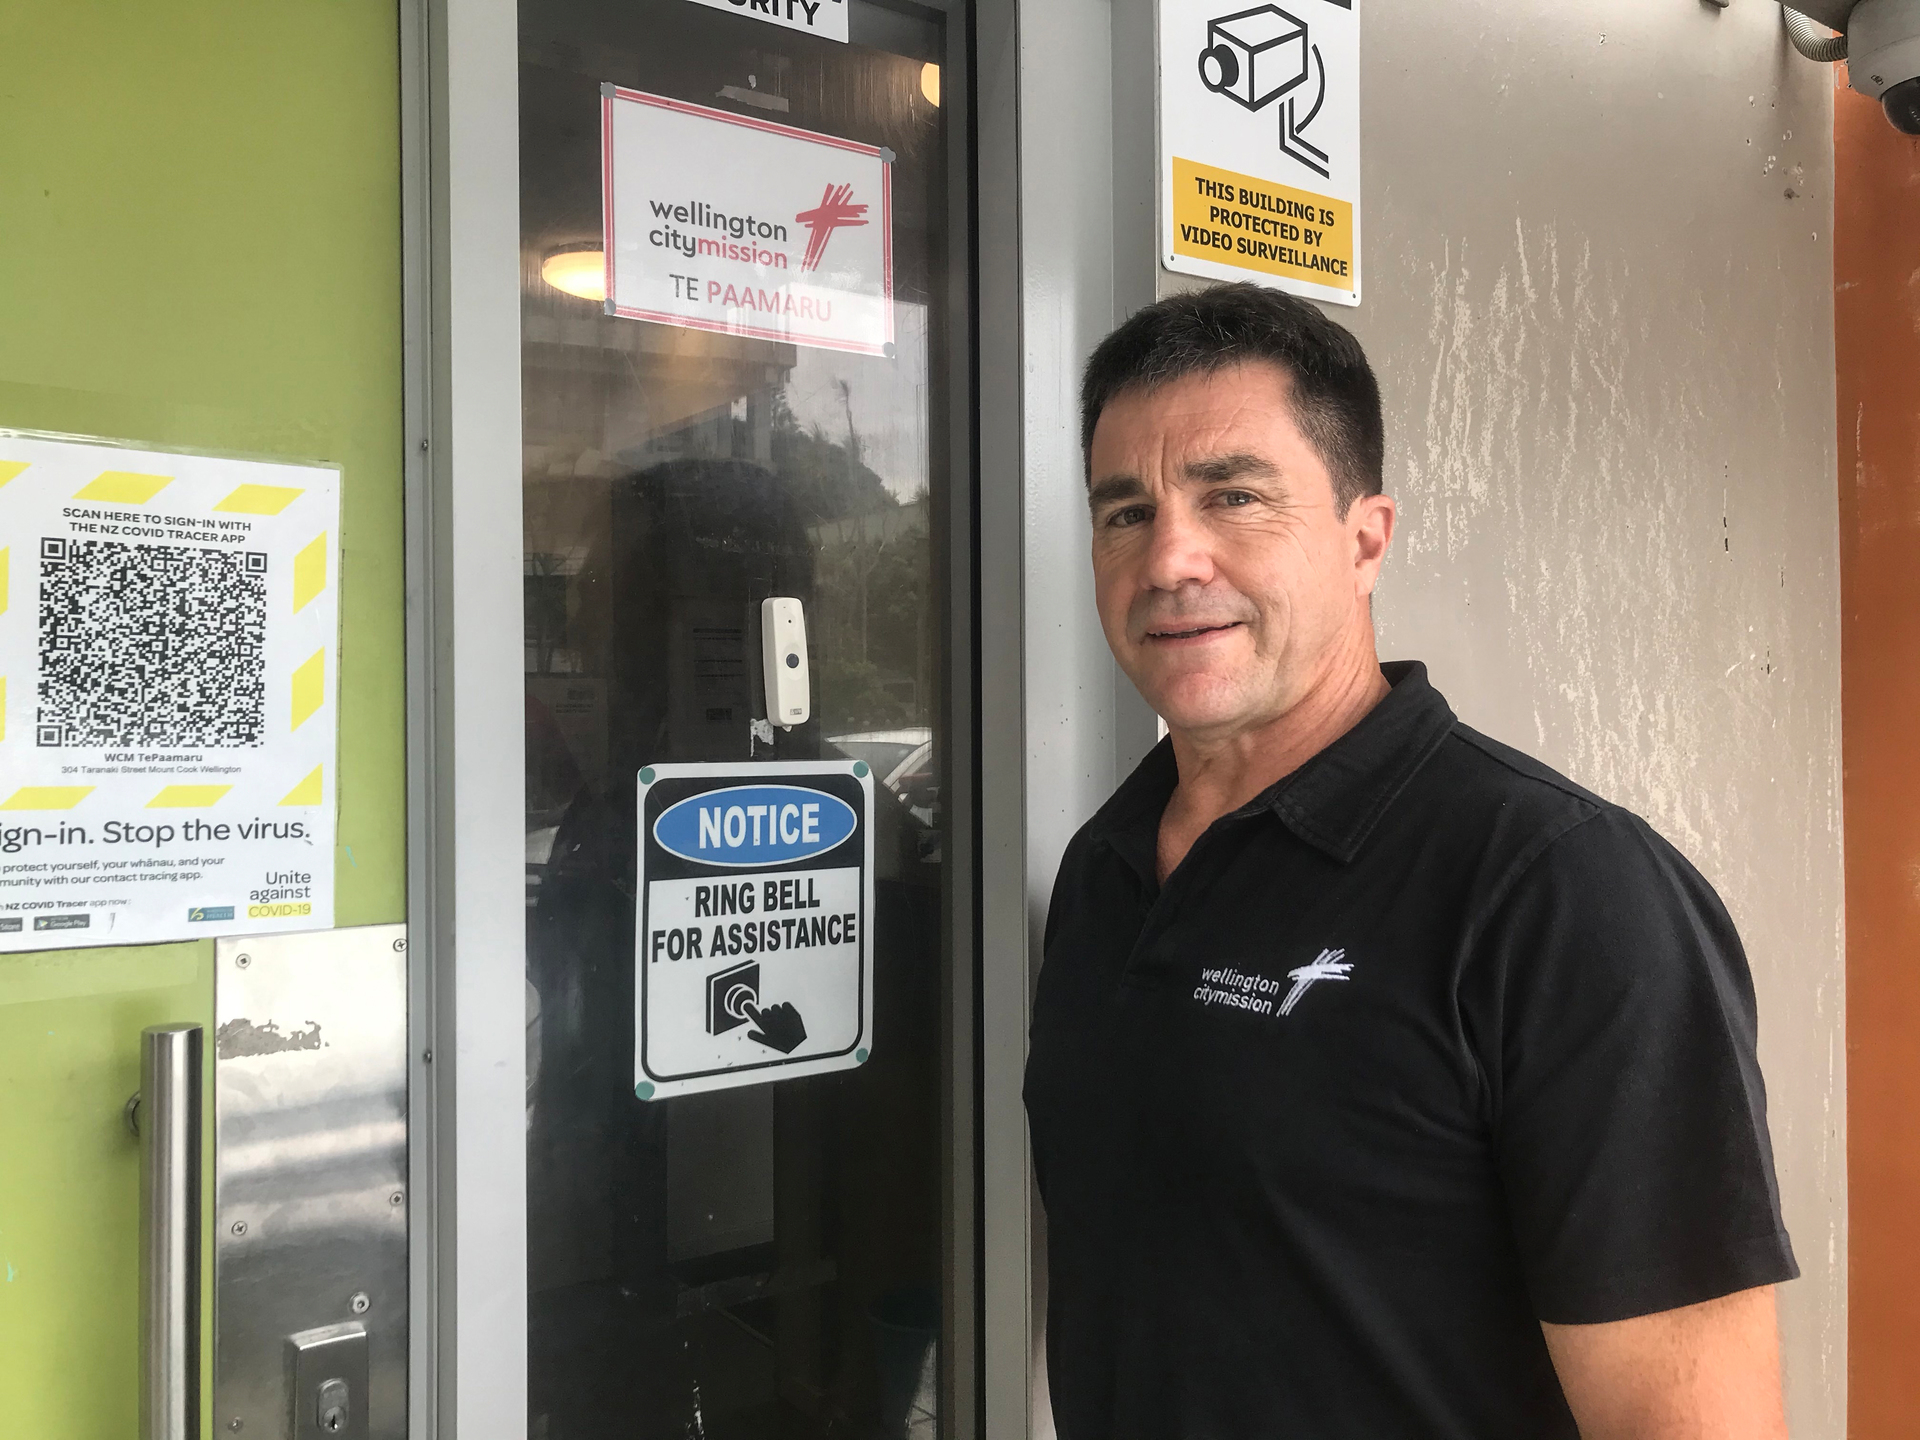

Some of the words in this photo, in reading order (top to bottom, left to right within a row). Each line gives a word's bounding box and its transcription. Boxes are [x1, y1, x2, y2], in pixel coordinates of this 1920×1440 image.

[1195, 176, 1235, 202] THIS
[1239, 188, 1314, 223] BUILDING
[1319, 209, 1335, 227] IS
[649, 200, 788, 242] wellington
[1209, 205, 1300, 242] PROTECTED
[1304, 231, 1323, 247] BY
[649, 225, 788, 269] citymission
[1180, 223, 1233, 251] VIDEO
[1236, 236, 1348, 277] SURVEILLANCE
[669, 273, 699, 301] TE
[707, 280, 832, 321] PAAMARU
[62, 507, 101, 520] SCAN
[104, 511, 140, 523] HERE
[145, 514, 161, 525] TO
[164, 516, 216, 528] SIGN-IN
[218, 520, 251, 531] WITH
[69, 522, 97, 533] THE
[100, 525, 119, 535] NZ
[122, 526, 164, 538] COVID
[167, 530, 218, 542] TRACER
[220, 534, 246, 544] APP
[61, 766, 79, 774] 304
[81, 766, 119, 774] Taranaki
[121, 766, 147, 774] Street
[148, 766, 175, 774] Mount
[176, 765, 199, 773] Cook
[200, 765, 242, 775] Wellington
[104, 753, 134, 762] WCM
[138, 753, 203, 762] TePaamaru
[103, 820, 175, 848] Stop
[182, 818, 231, 841] the
[237, 817, 311, 840] virus.
[699, 803, 820, 849] NOTICE
[3, 863, 48, 874] protect
[50, 860, 100, 873] yourself,
[102, 861, 128, 871] your
[178, 857, 199, 867] and
[200, 857, 225, 867] your
[44, 875, 69, 885] with
[71, 876, 91, 884] our
[93, 873, 137, 883] contact
[139, 871, 178, 881] tracing
[179, 871, 203, 881] app.
[266, 870, 311, 885] Unite
[22, 901, 55, 909] COVID
[56, 900, 88, 908] Tracer
[89, 899, 108, 907] app
[250, 885, 311, 904] against
[694, 881, 755, 918] RING
[763, 877, 820, 912] BELL
[248, 903, 311, 918] COVID-19
[652, 926, 702, 963] FOR
[710, 913, 856, 959] ASSISTANCE
[1201, 967, 1280, 996] wellington
[1193, 983, 1273, 1015] citymission
